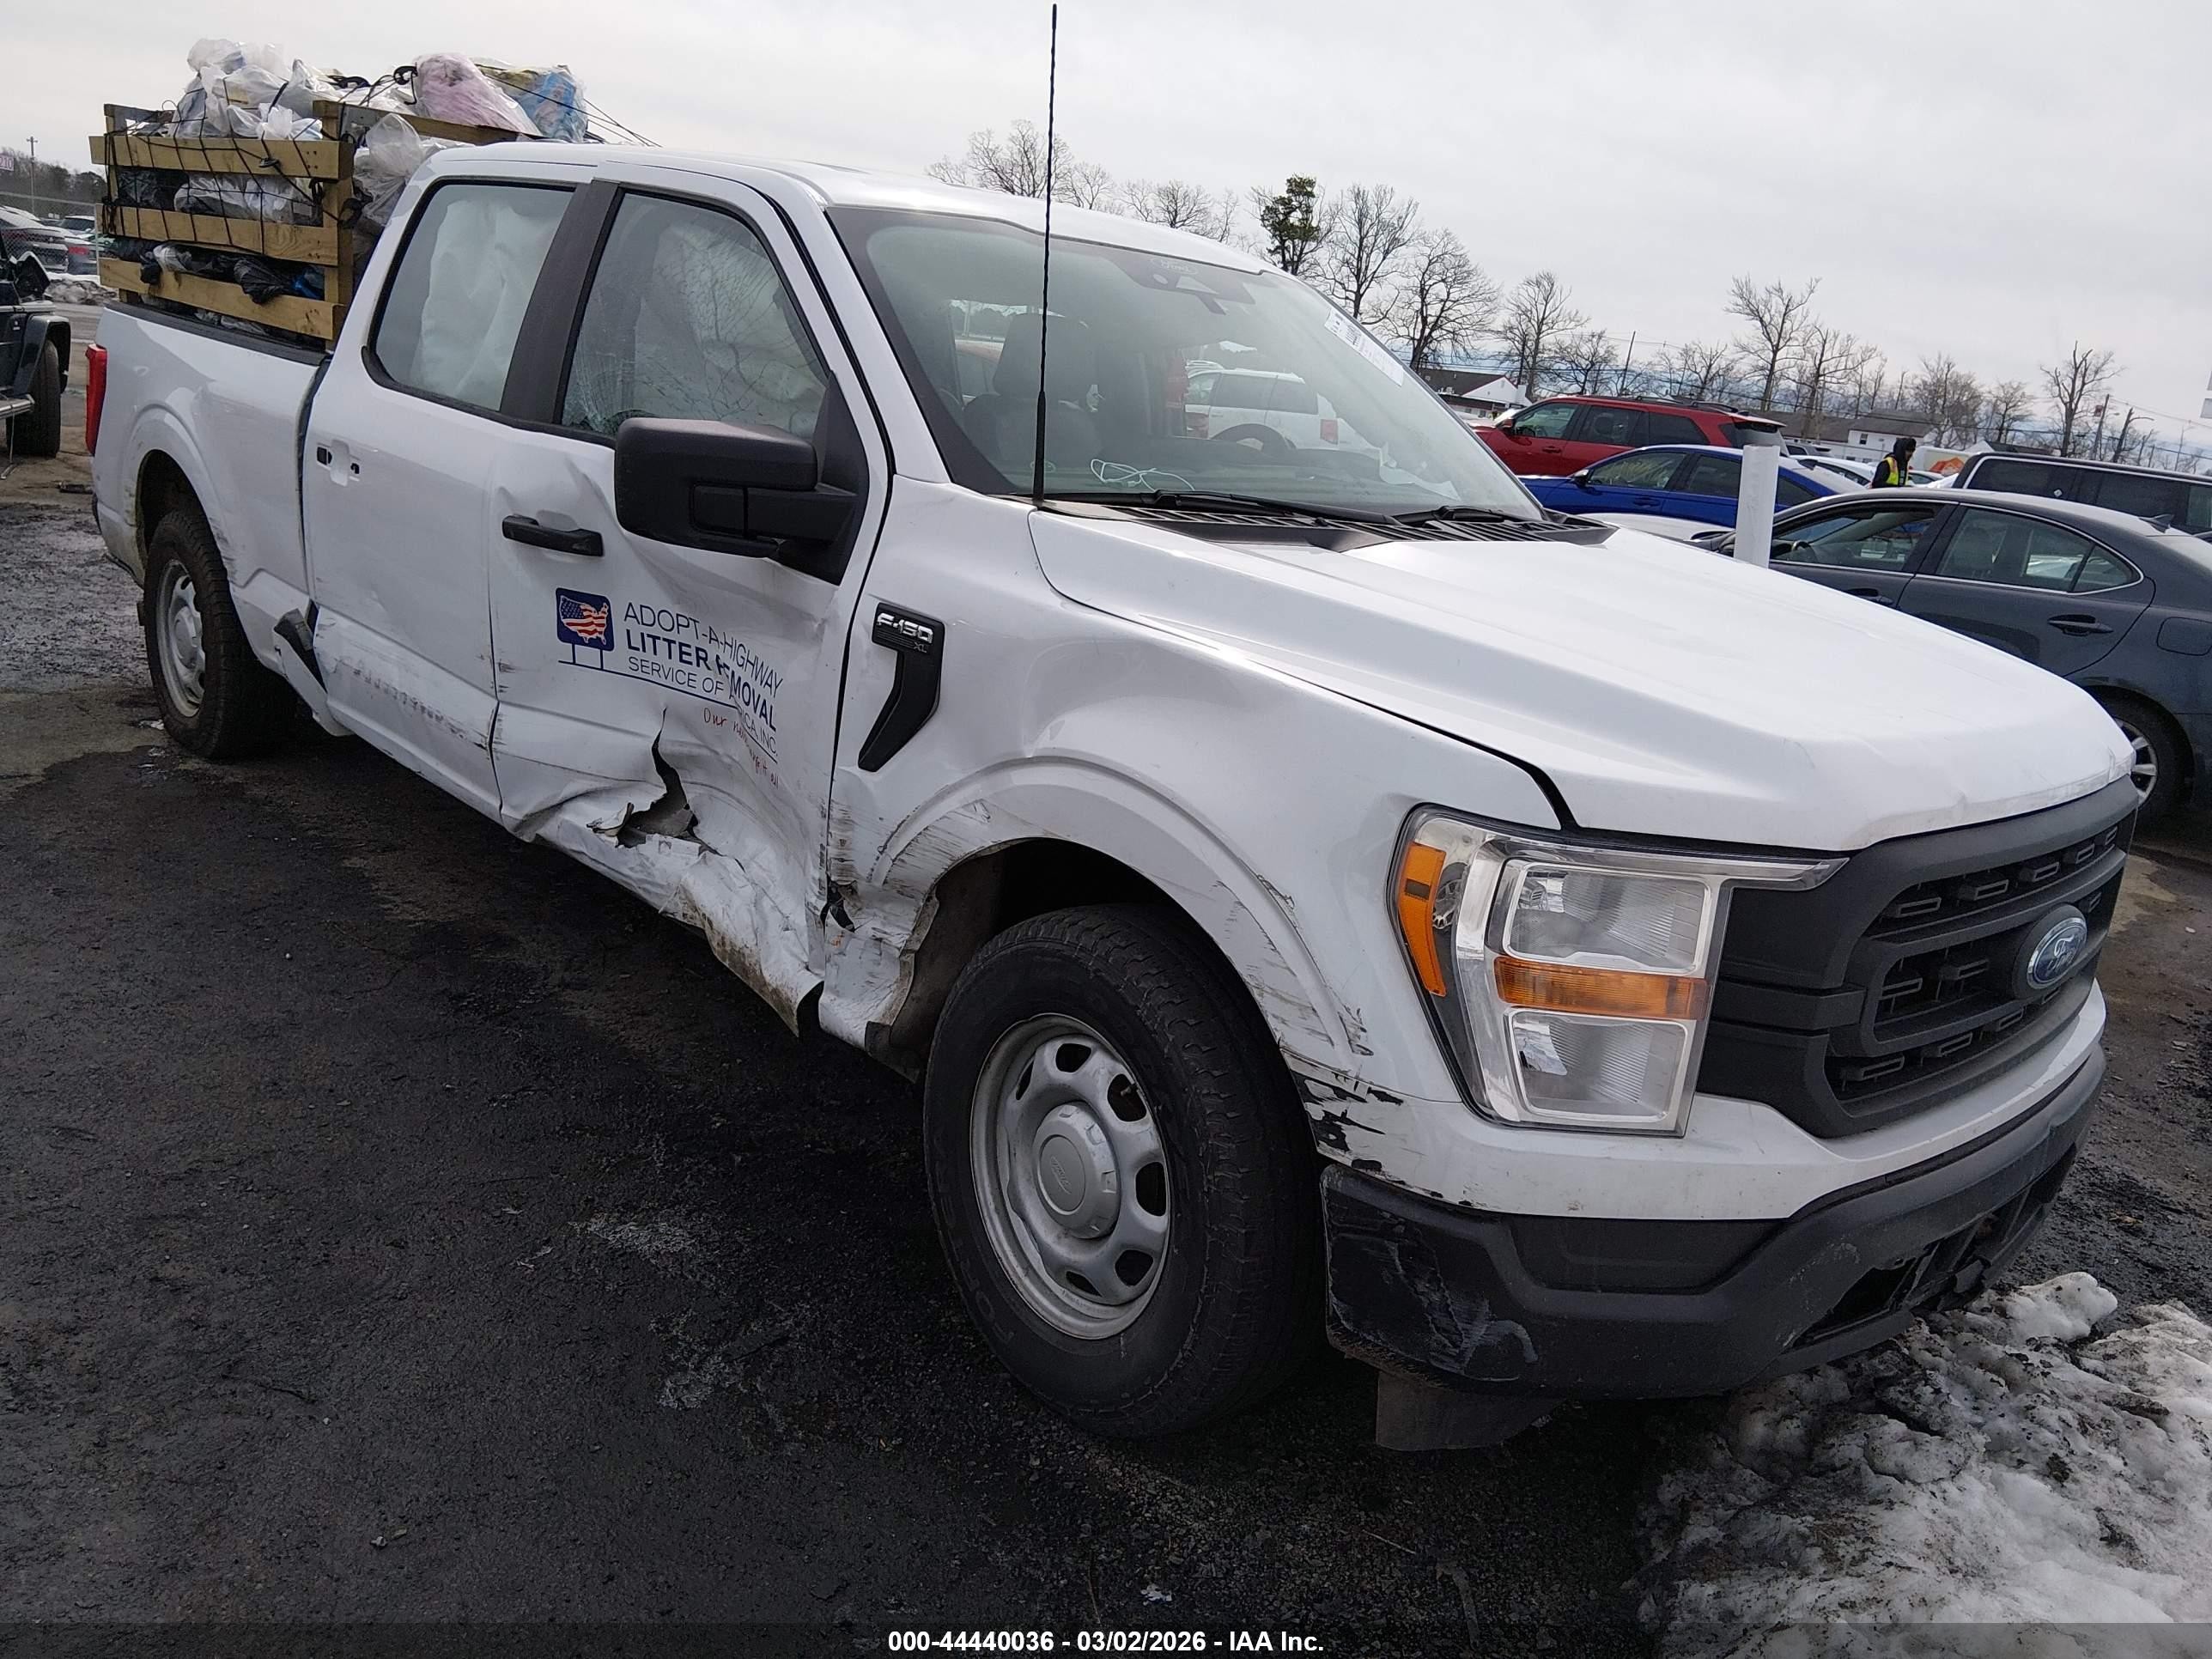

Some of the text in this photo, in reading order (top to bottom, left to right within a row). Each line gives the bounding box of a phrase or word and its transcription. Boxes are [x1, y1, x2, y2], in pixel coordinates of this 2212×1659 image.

[877, 612, 933, 643] F-150
[913, 641, 927, 653] XL
[624, 602, 783, 698] ADOPT-A-HIGHWAY
[626, 629, 712, 672] LITTER
[629, 656, 697, 689] SERVICE
[702, 677, 724, 695] OF
[760, 727, 778, 757] INC.
